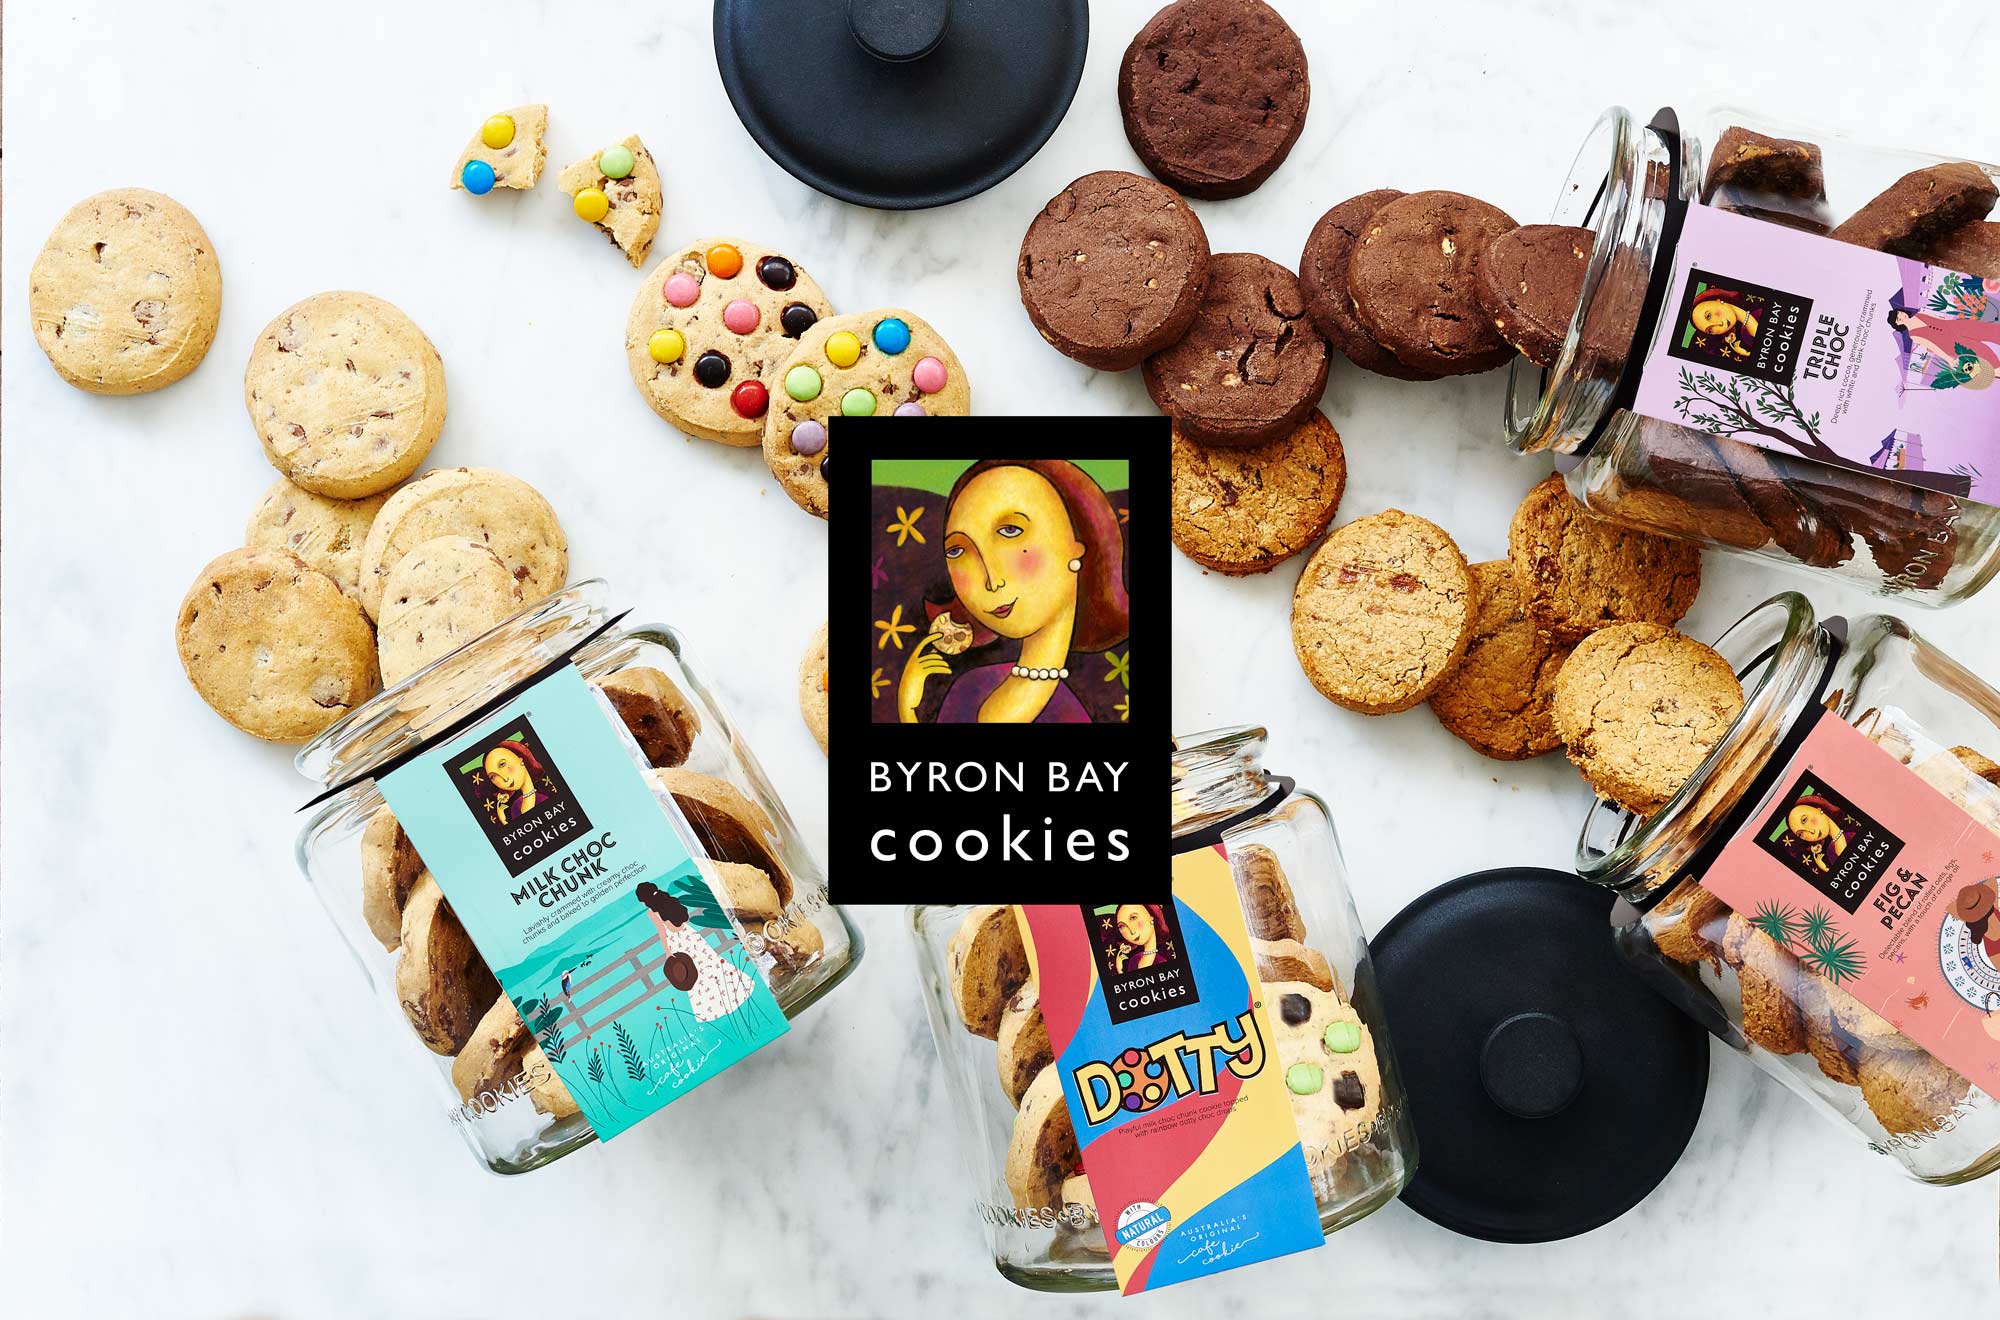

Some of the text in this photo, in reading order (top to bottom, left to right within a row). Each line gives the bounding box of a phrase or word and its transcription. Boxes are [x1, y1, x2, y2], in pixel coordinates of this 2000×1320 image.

[1757, 302, 1782, 368] BYRON BAY
[1865, 302, 1876, 328] chunks
[1774, 306, 1800, 372] cookies
[1803, 314, 1834, 379] TRIPLE
[1822, 323, 1850, 380] CHOC
[1831, 290, 1873, 424] Deep, rich cocoa, generously crammed
[1856, 347, 1864, 364] dark
[1860, 329, 1870, 346] choc
[1842, 400, 1851, 415] with
[1846, 381, 1856, 400] white
[502, 802, 566, 846] BYRON BAY
[513, 817, 577, 861] cookies
[510, 832, 616, 906] MILK CHOC
[1830, 831, 1875, 889] BYRON BAY
[1844, 841, 1890, 898] cookies
[522, 863, 648, 944] chunks and baked to golden perfection
[523, 860, 639, 934] Lavishly crammed with creamy choc
[538, 858, 608, 908] CHUNK
[1872, 867, 1914, 912] FIG &
[1880, 872, 1928, 930] PECAN
[1878, 927, 1904, 960] Delectable
[1902, 909, 1918, 928] blend
[1921, 884, 1936, 904] rolled
[1934, 871, 1947, 886] oats,
[1887, 937, 1907, 962] pecans,
[1905, 924, 1917, 938] with
[1918, 900, 1933, 920] touch
[1936, 872, 1954, 896] orange
[1114, 968, 1181, 994] BYRON BAY
[1119, 985, 1186, 1011] cookies
[641, 1025, 704, 1068] AUSTRALIA'S
[653, 1037, 702, 1069] ORIGINAL
[672, 1039, 722, 1088] cookie
[1072, 1009, 1267, 1127] DOTTY
[460, 1061, 552, 1121] COOKIES
[1118, 1096, 1248, 1136] Playful milk choc chunk cookie topped
[1134, 1106, 1238, 1138] with rainbow dotty choc drops
[1121, 1212, 1164, 1240] NATURAL
[1125, 1204, 1142, 1216] WITH
[1180, 1214, 1247, 1236] AUSTRALIA'S
[1136, 1230, 1165, 1247] COLOURS
[1177, 1239, 1220, 1264] cafe
[1190, 1224, 1240, 1242] ORIGINAL
[1202, 1232, 1260, 1265] cookie
